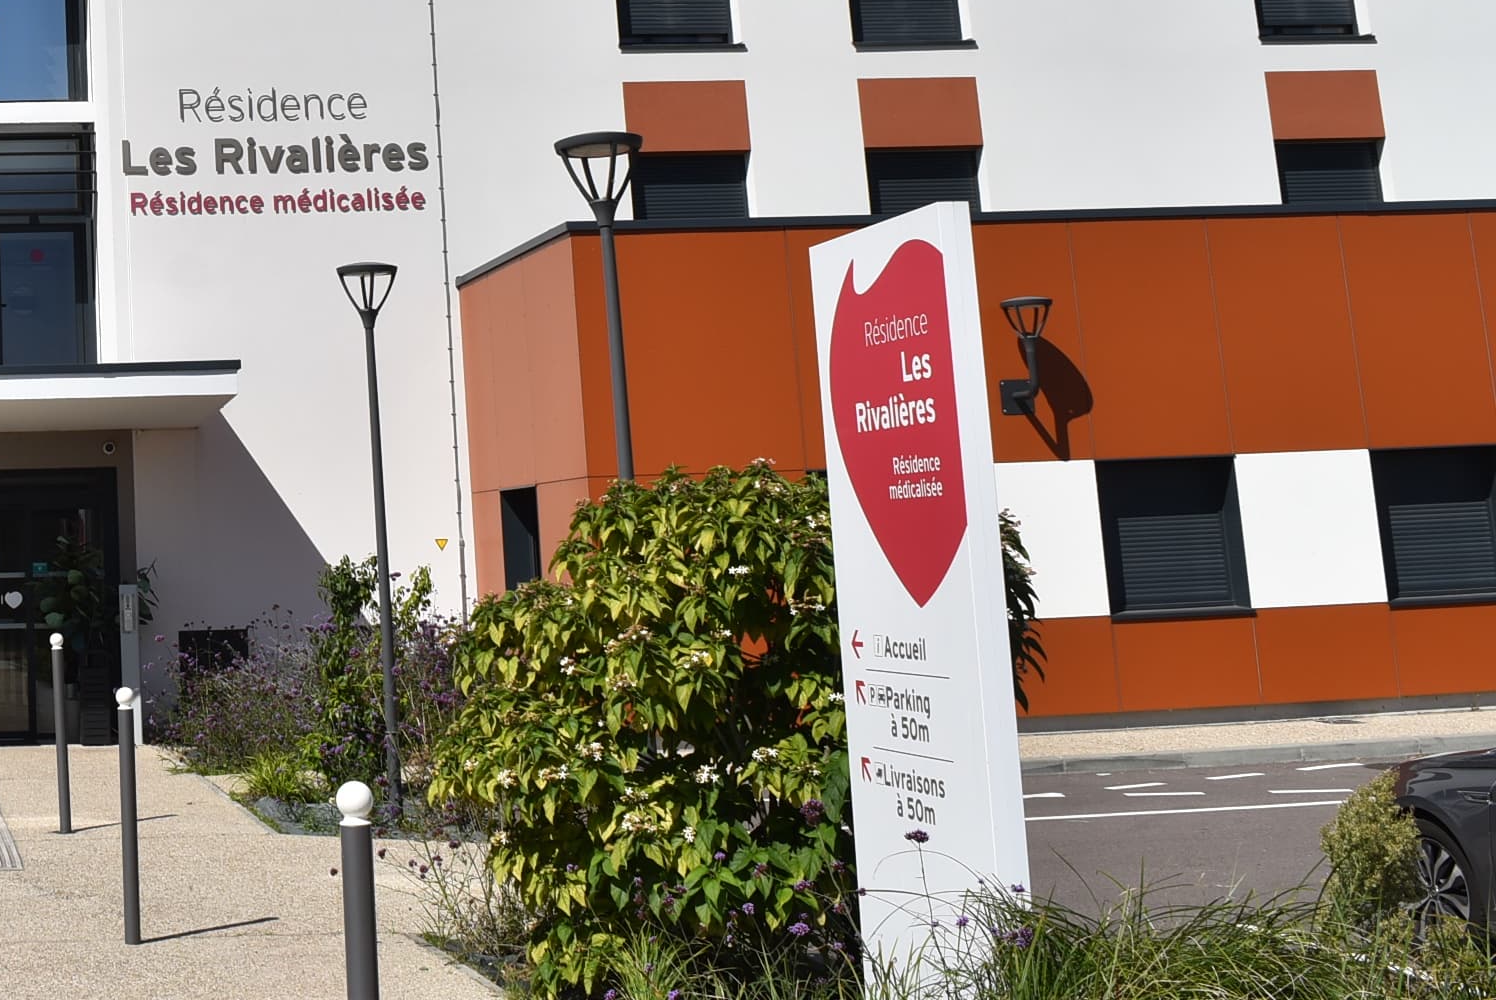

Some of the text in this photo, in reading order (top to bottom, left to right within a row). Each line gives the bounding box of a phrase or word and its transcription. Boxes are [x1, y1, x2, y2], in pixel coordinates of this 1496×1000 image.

[178, 86, 368, 123] Résidence
[121, 133, 429, 176] Les Rivalières
[129, 185, 426, 216] Résidence médicalisée
[864, 312, 929, 348] Résidence
[900, 350, 932, 383] Les
[855, 392, 936, 433] Rivalières
[892, 452, 941, 475] Résidence
[889, 478, 943, 501] médicalisée
[884, 635, 927, 661] Accueil
[885, 685, 931, 720] Parking
[891, 713, 930, 743] à 50m
[883, 763, 946, 799] Livraisons
[896, 793, 937, 826] à 50m
